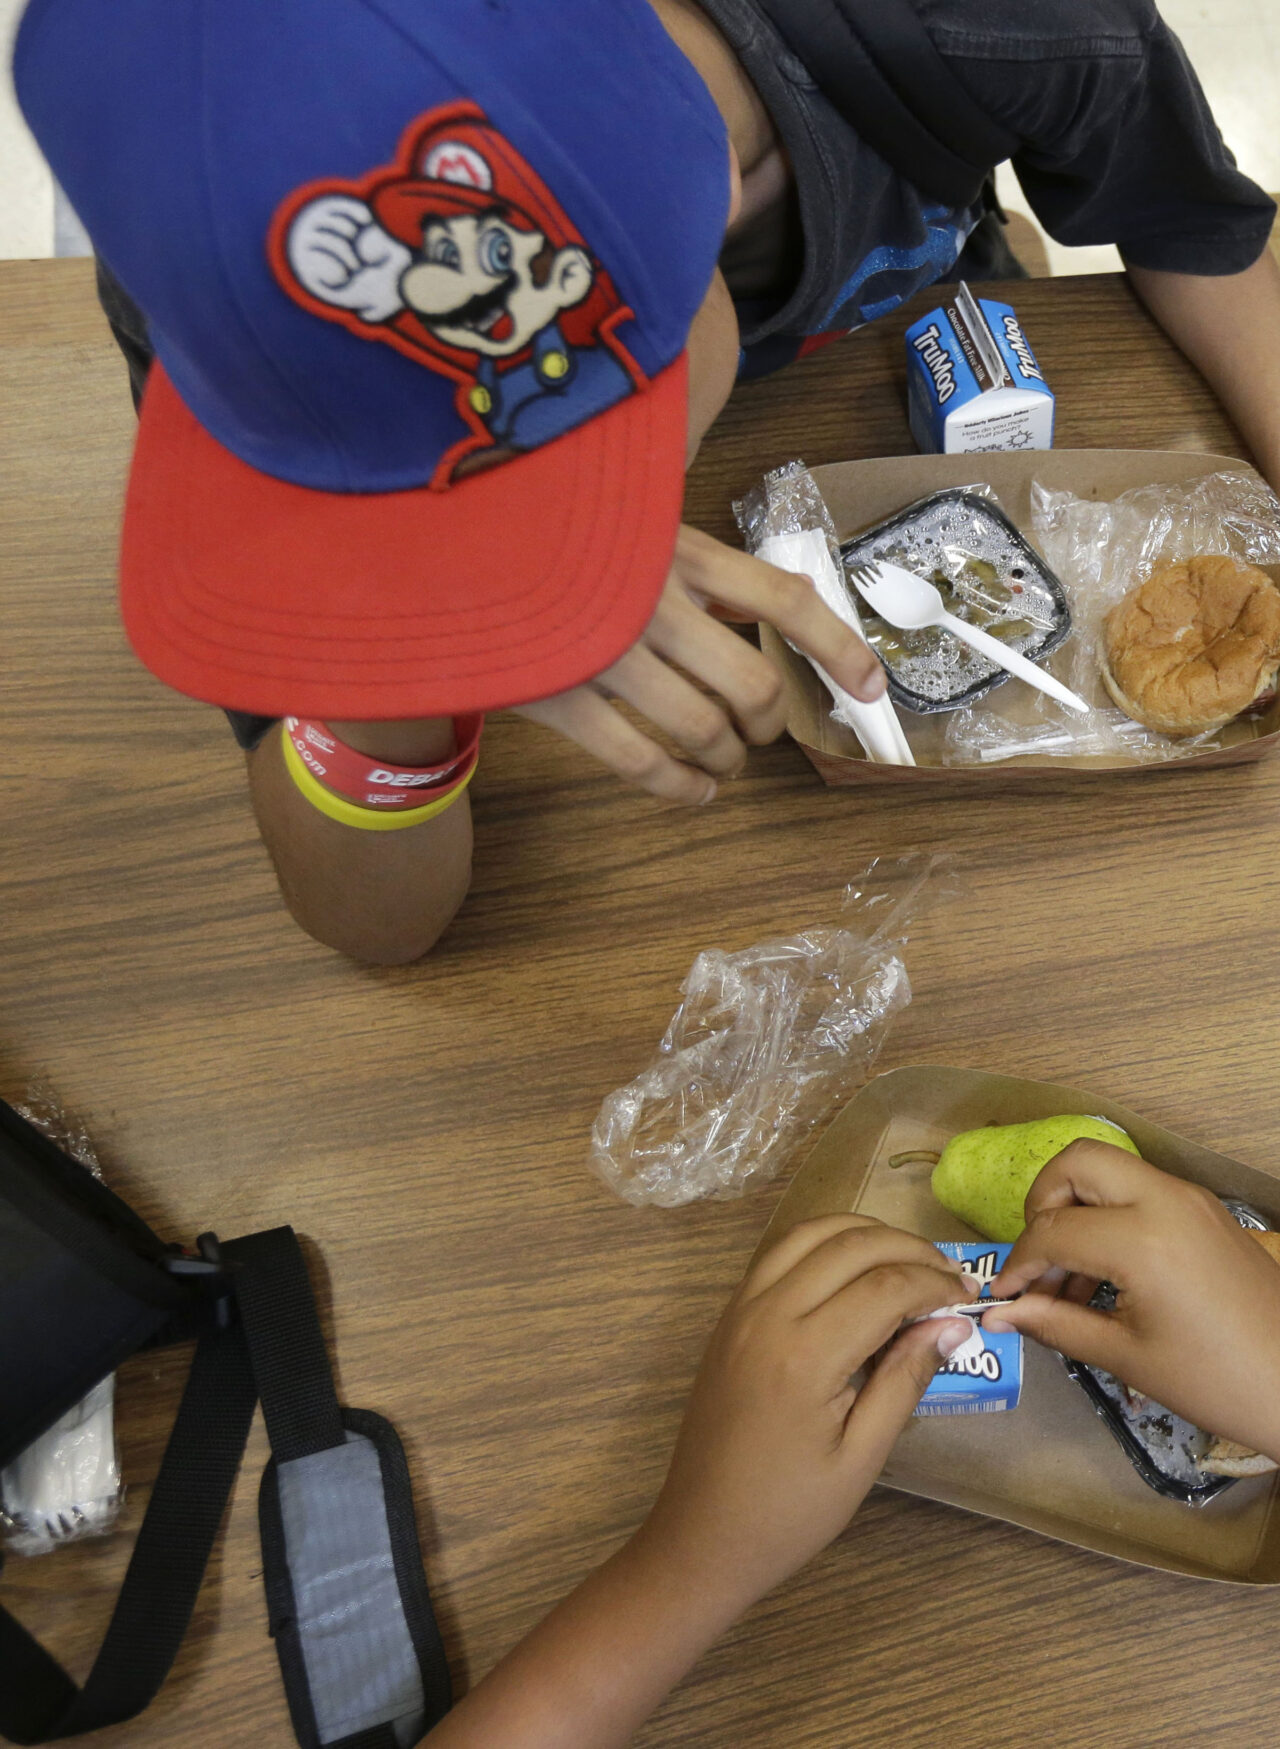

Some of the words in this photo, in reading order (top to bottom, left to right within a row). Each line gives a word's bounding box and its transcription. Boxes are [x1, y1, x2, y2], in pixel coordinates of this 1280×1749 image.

[436, 153, 483, 187] M
[947, 308, 966, 340] Chocolate
[962, 339, 973, 353] Fat
[1003, 316, 1043, 380] TruMoo
[912, 324, 957, 404] TruMoo
